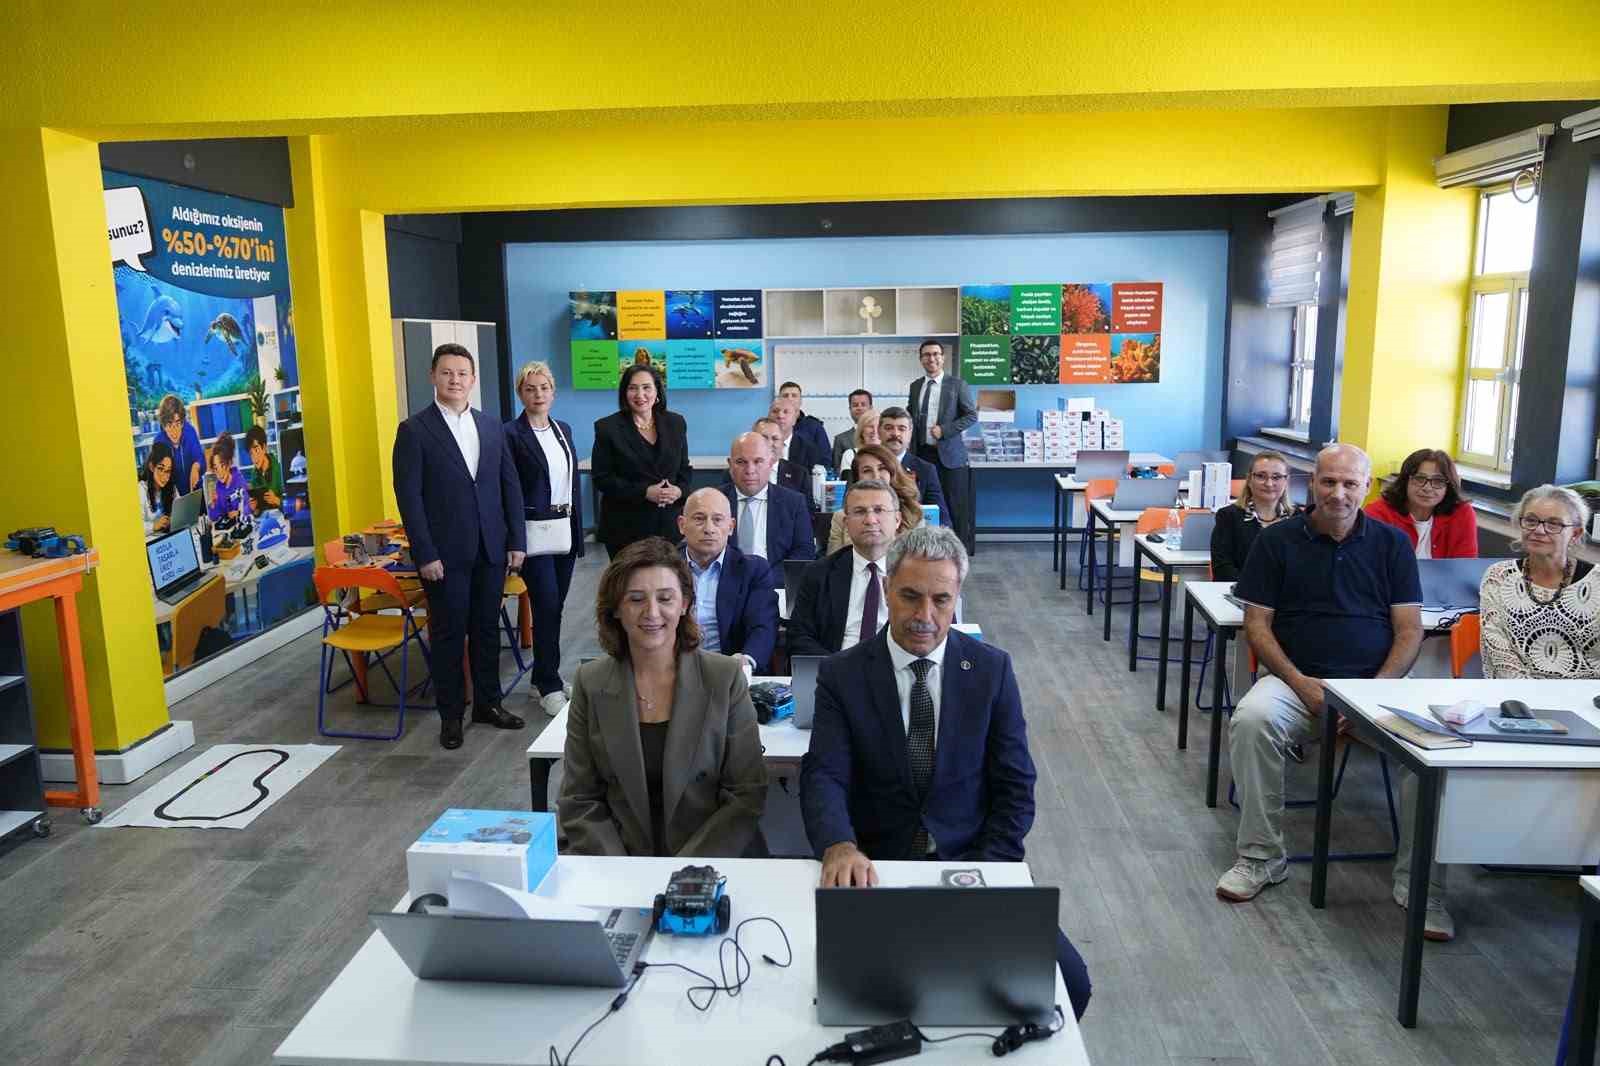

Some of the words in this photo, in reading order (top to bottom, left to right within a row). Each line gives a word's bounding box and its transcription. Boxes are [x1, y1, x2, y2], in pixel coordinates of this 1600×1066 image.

[172, 206, 220, 227] Aldığımız
[221, 213, 263, 232] oksijenin
[172, 262, 234, 279] denizlerimiz
[235, 266, 270, 282] üretiyor
